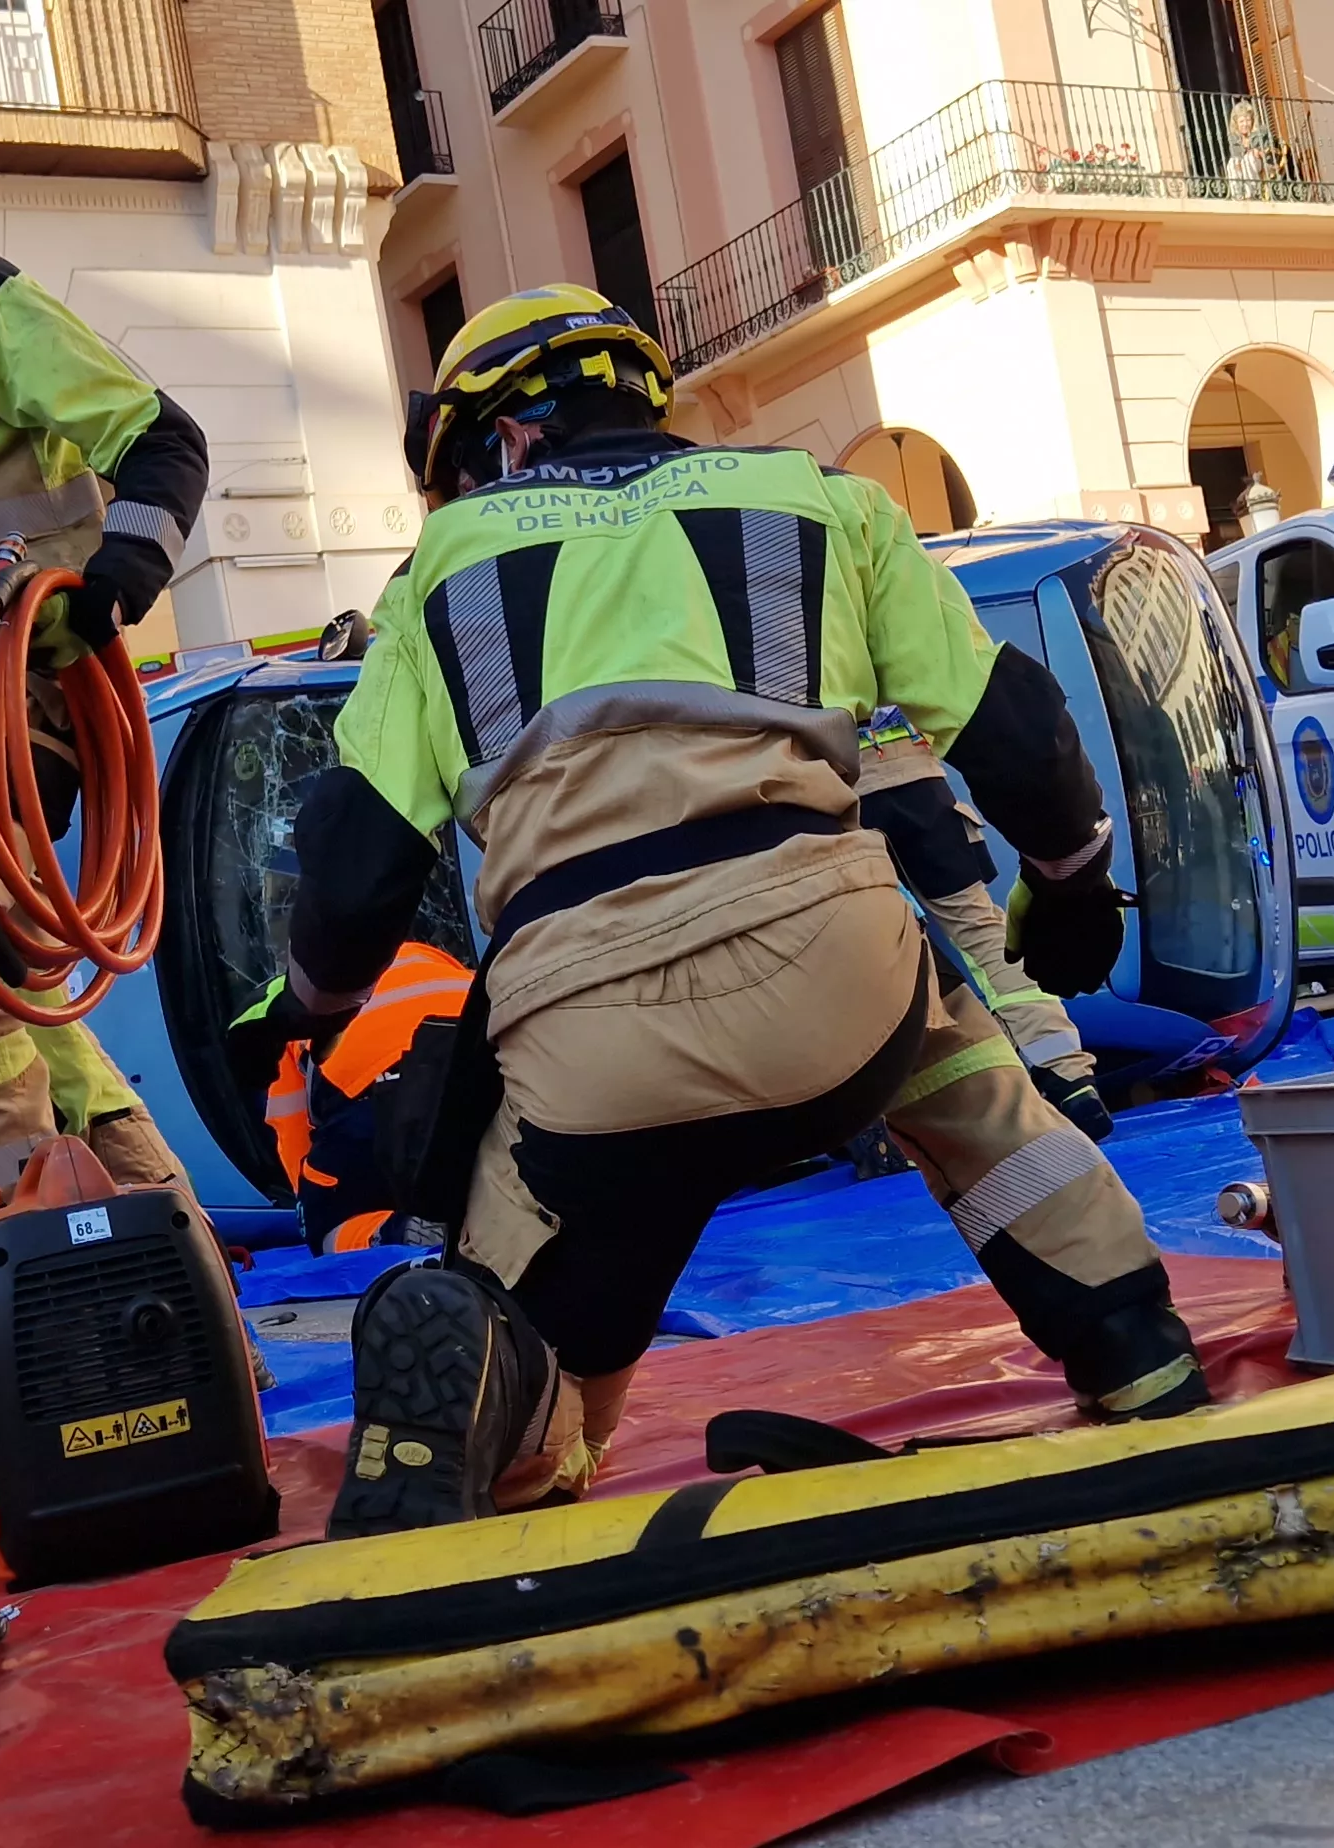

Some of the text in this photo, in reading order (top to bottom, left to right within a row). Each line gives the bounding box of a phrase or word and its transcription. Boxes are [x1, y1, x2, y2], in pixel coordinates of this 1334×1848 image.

[479, 456, 740, 517] AYUNTAMIENTO
[516, 480, 709, 532] DE HUESCA
[76, 1221, 94, 1237] 68
